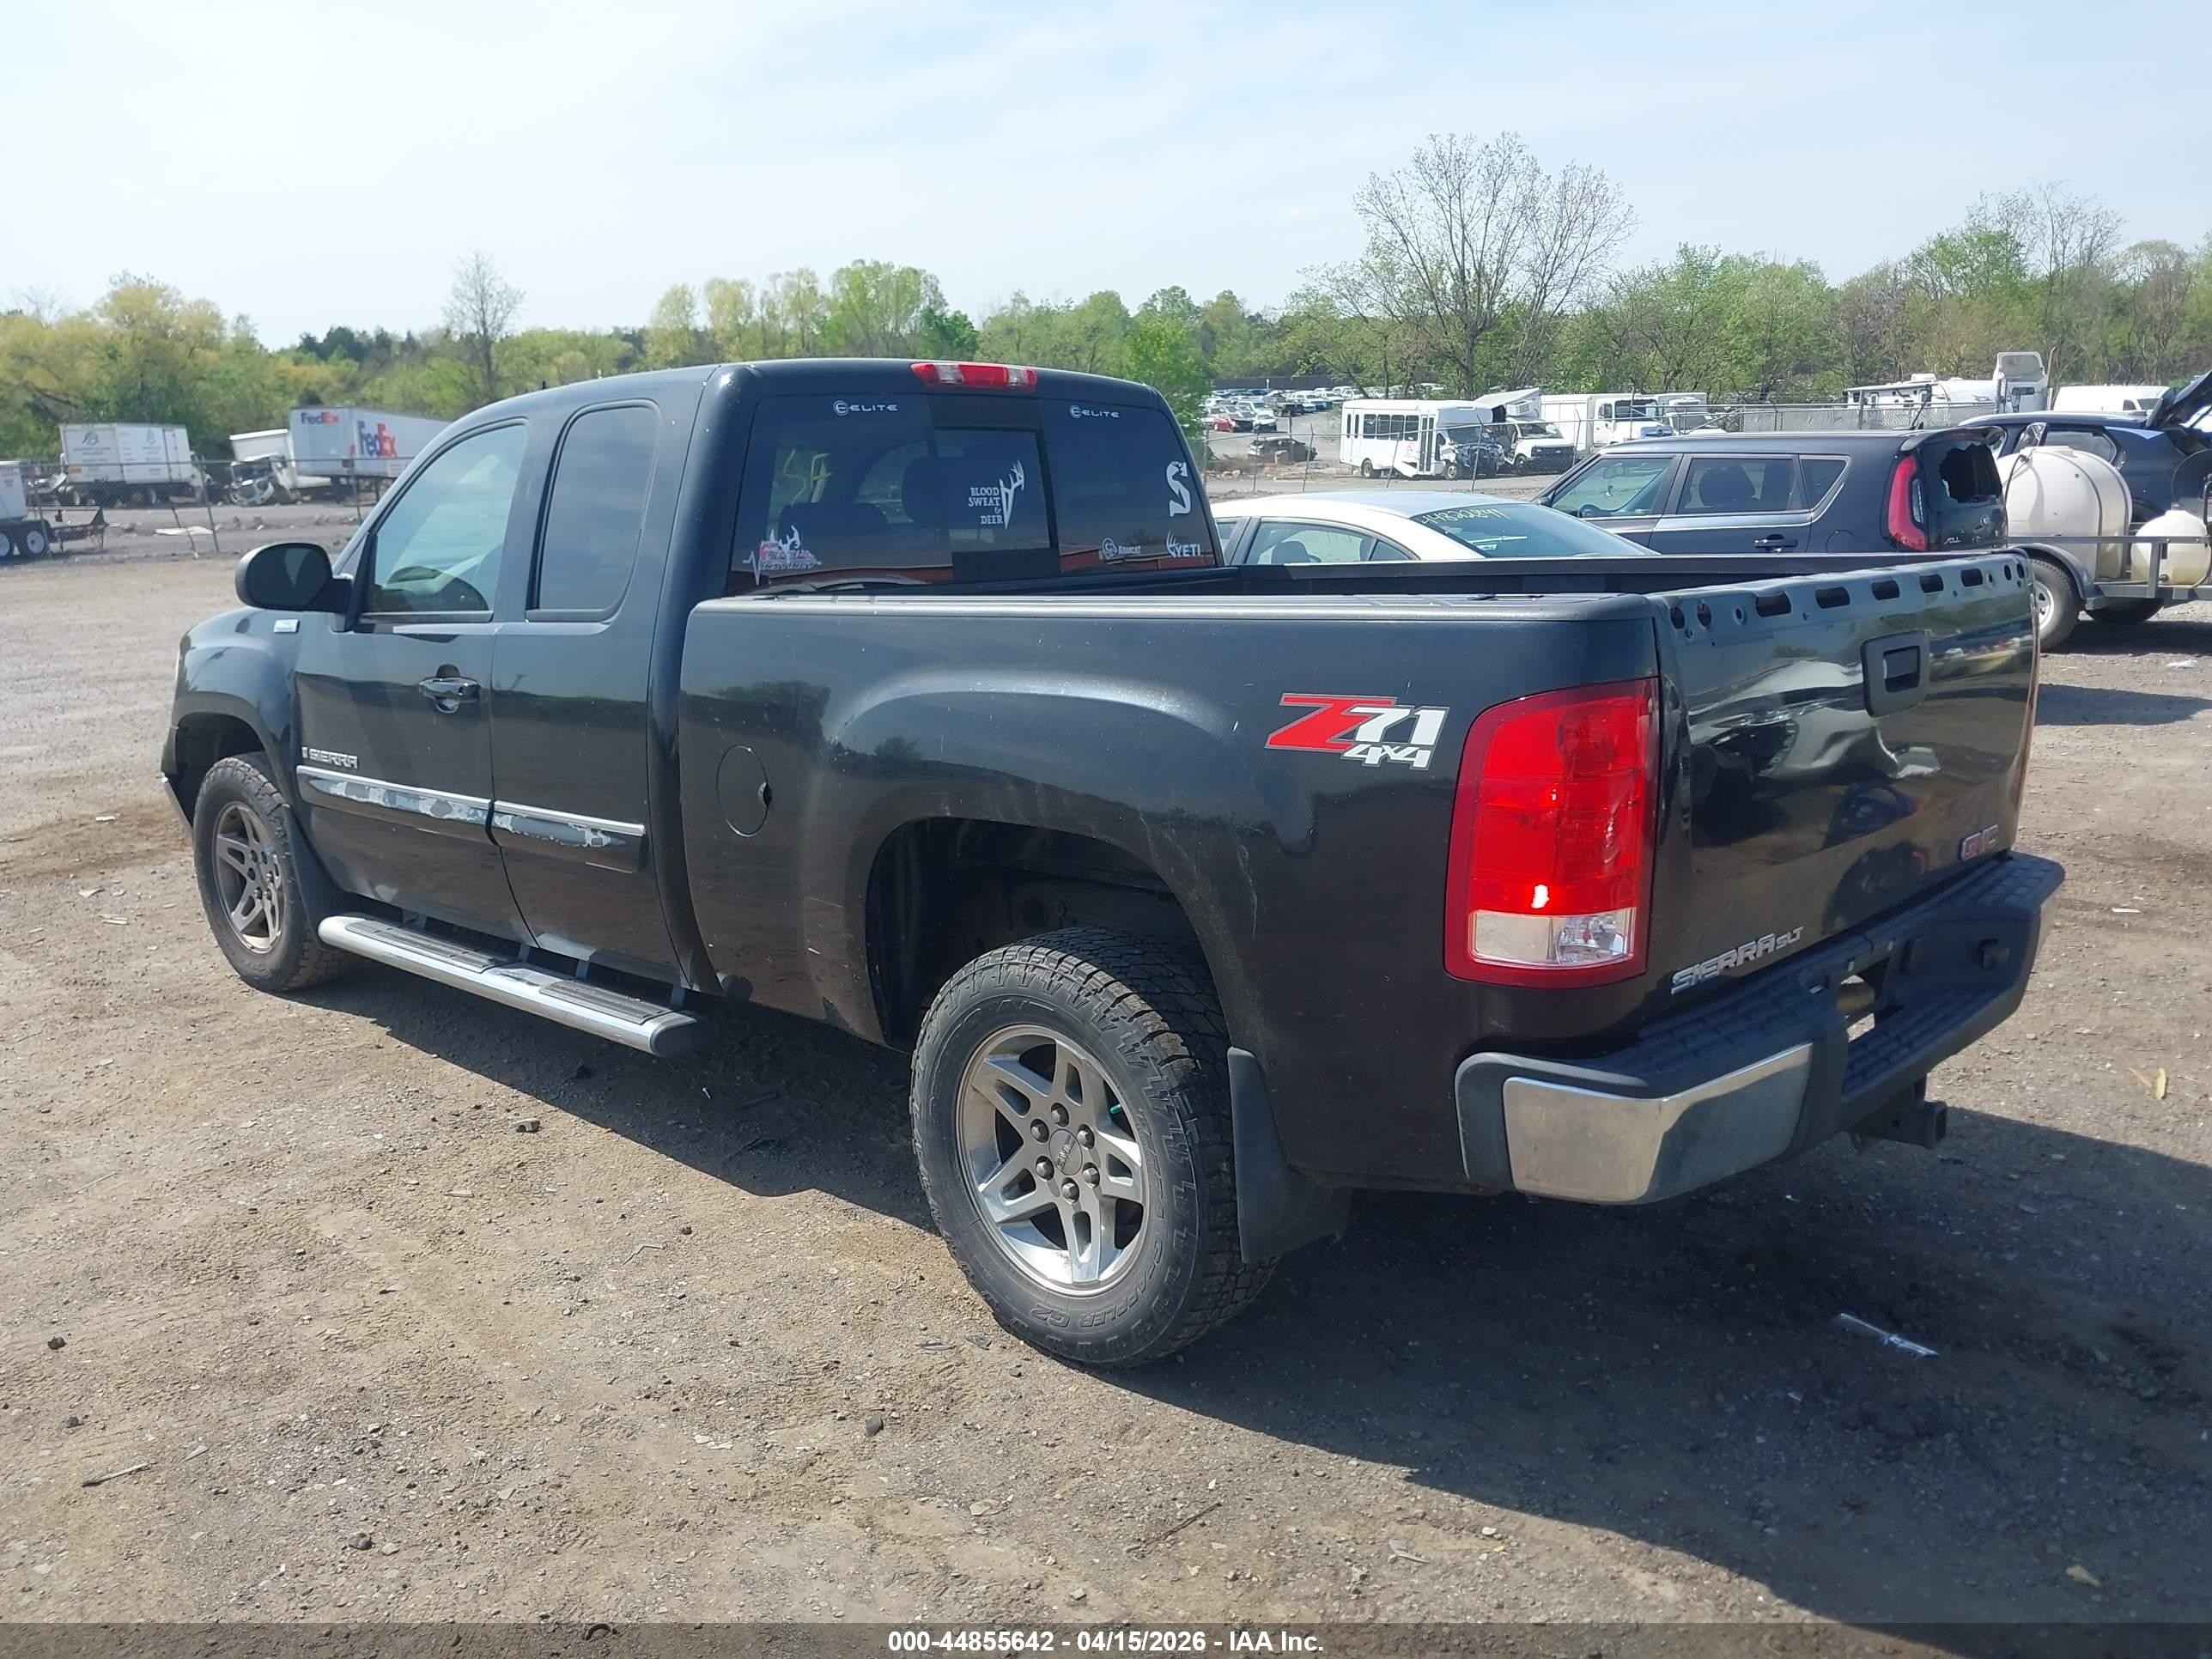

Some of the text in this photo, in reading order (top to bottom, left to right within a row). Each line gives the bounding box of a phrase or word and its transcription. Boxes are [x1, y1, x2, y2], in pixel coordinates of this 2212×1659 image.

[301, 412, 339, 425] FedEx
[357, 420, 398, 458] FedEx
[968, 496, 1001, 507] SWEAT
[969, 487, 1000, 496] BLOOD
[980, 515, 1004, 525] DEER
[1176, 544, 1200, 557] YETI
[1264, 692, 1450, 753] Z71
[309, 747, 358, 769] SIERRA
[1961, 824, 1999, 860] GMC
[1671, 926, 1805, 995] SIERRA SLT
[1056, 1134, 1075, 1170] GMC
[1030, 1303, 1072, 1328] G2
